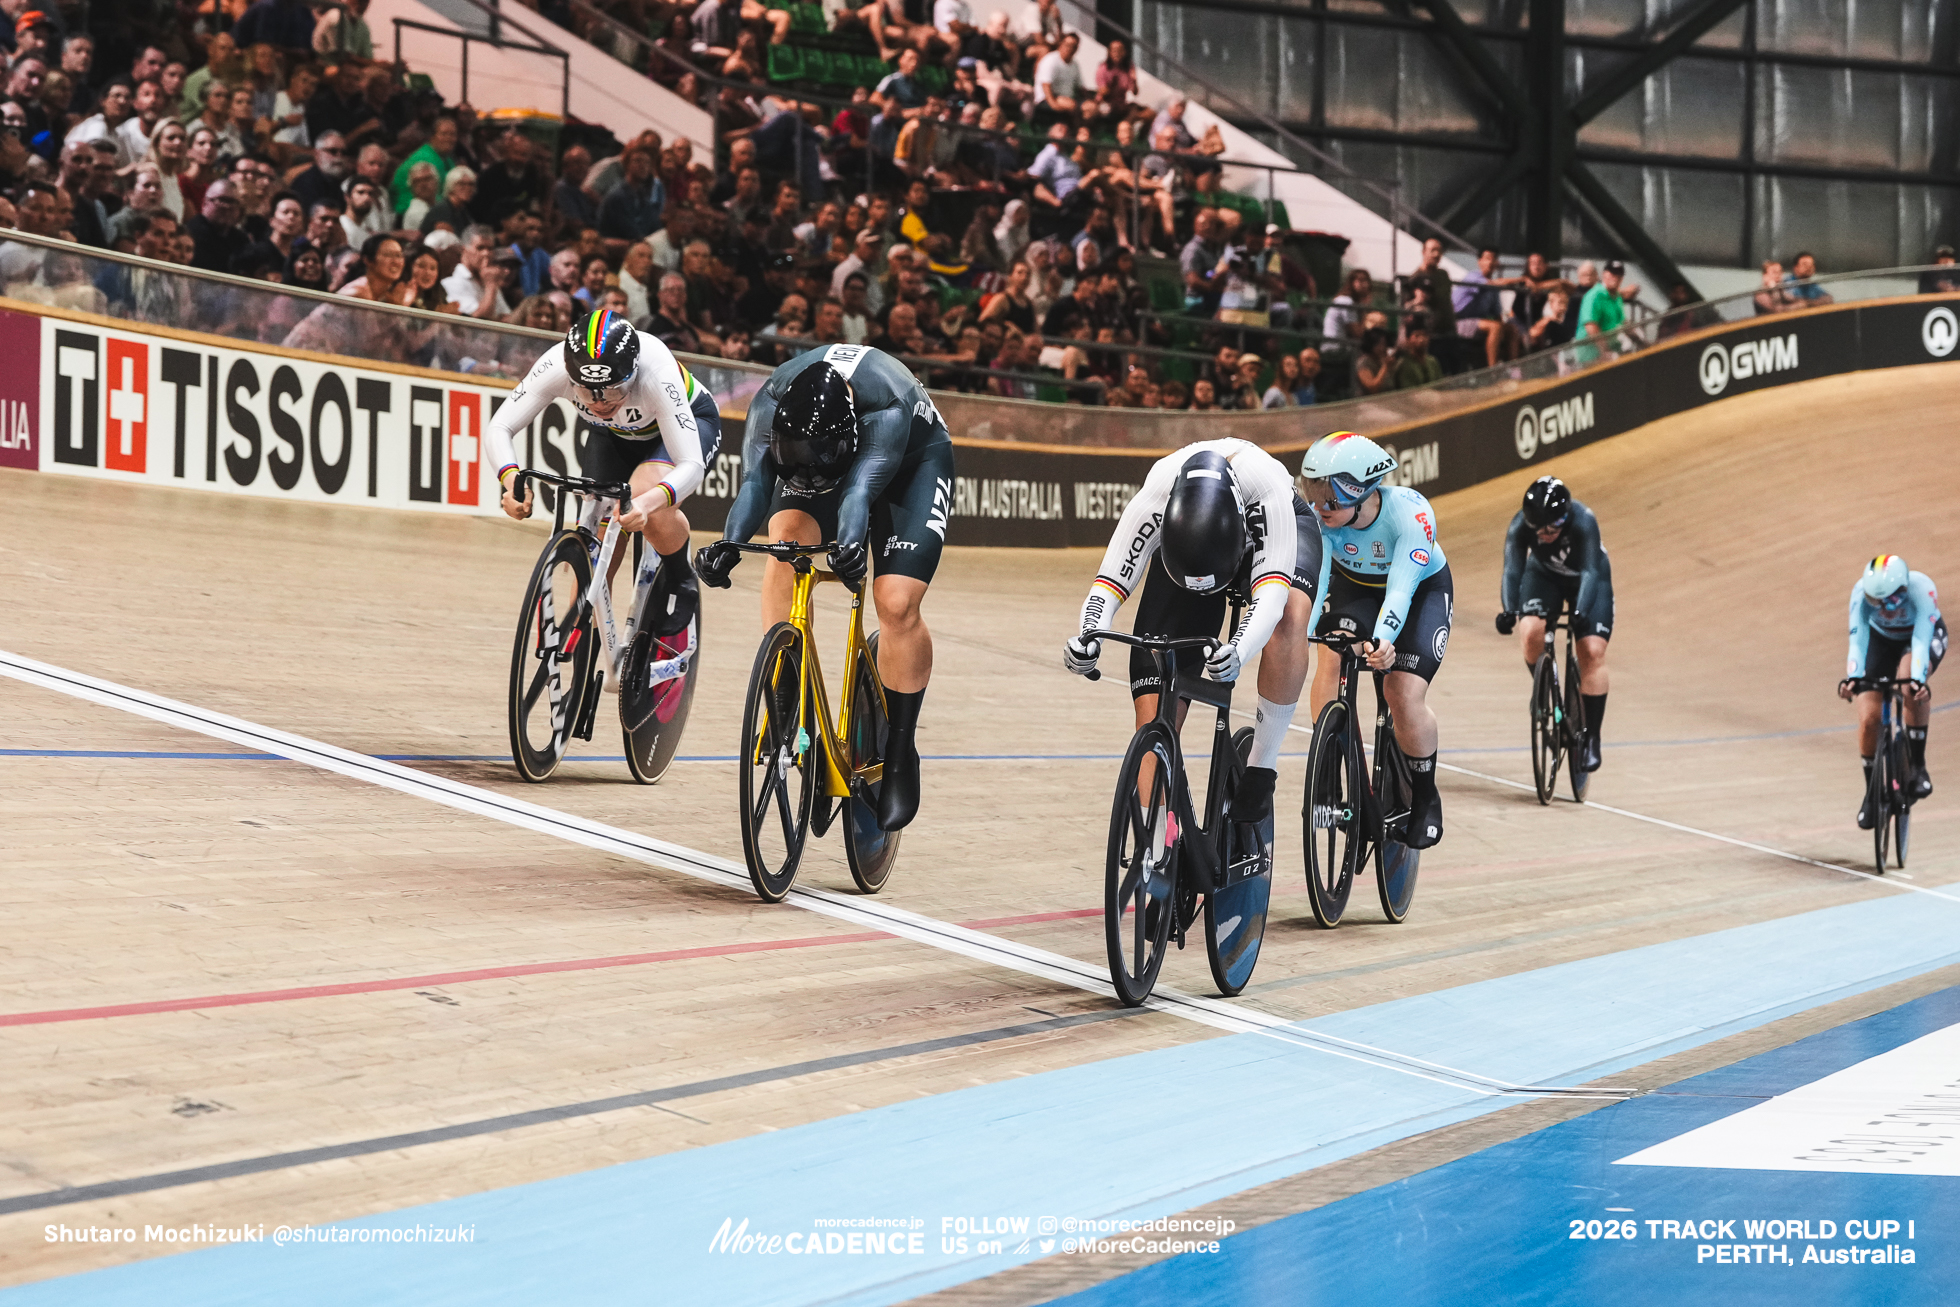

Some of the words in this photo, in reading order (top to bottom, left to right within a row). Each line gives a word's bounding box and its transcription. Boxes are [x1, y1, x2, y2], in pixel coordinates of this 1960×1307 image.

[615, 326, 632, 354] JAPAN
[1731, 334, 1798, 377] GWM
[161, 346, 391, 498] TISSOT
[1540, 391, 1594, 444] GWM
[1400, 441, 1439, 487] GWM
[926, 477, 951, 541] NZL
[980, 478, 1063, 520] AUSTRALIA
[1074, 482, 1140, 520] WESTER
[885, 541, 918, 551] SIXTY
[1245, 500, 1268, 553] KTM
[1293, 574, 1313, 589] MANY
[1081, 595, 1106, 635] BIORAC
[1383, 610, 1402, 632] EY
